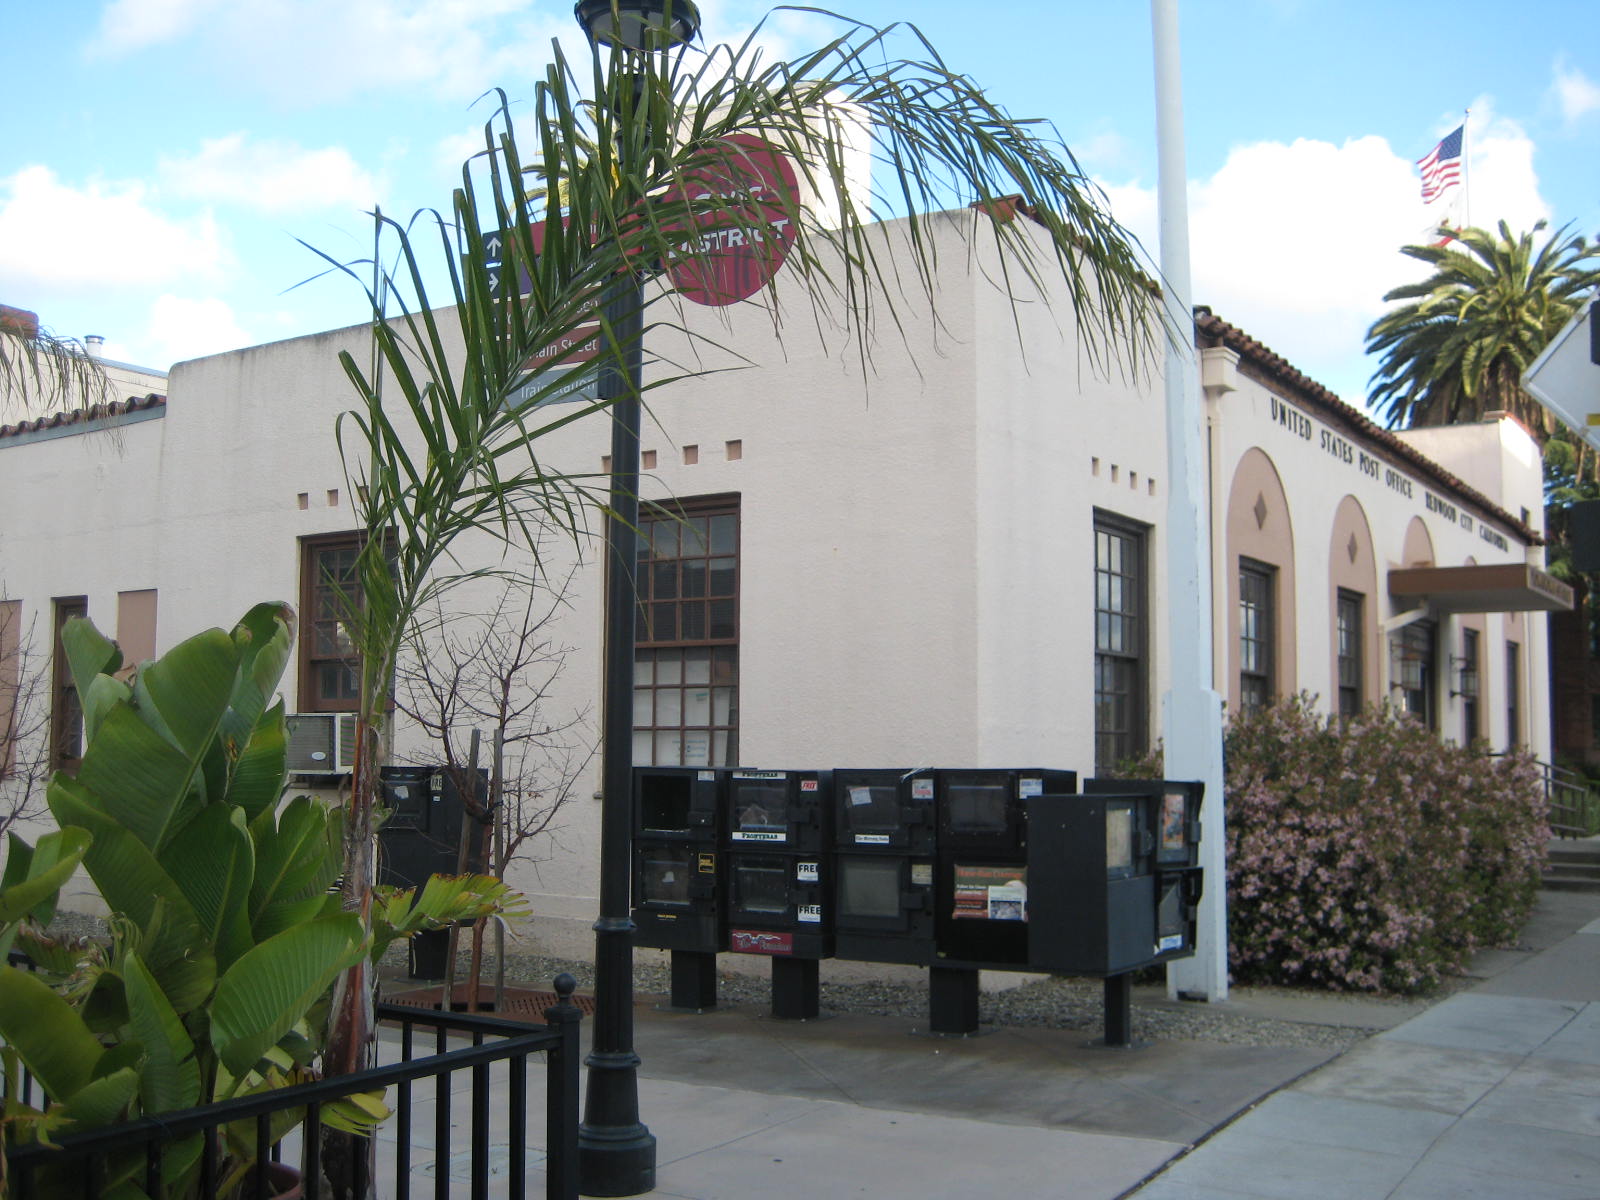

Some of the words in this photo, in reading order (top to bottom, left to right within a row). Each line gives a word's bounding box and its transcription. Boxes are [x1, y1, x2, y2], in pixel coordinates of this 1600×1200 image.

[529, 344, 558, 360] ain
[561, 338, 597, 354] Stet
[1270, 397, 1312, 441] UNITED
[1320, 429, 1353, 464] STATES
[1359, 451, 1380, 480] POST
[1385, 469, 1413, 499] OFFICE
[799, 905, 822, 915] FREE
